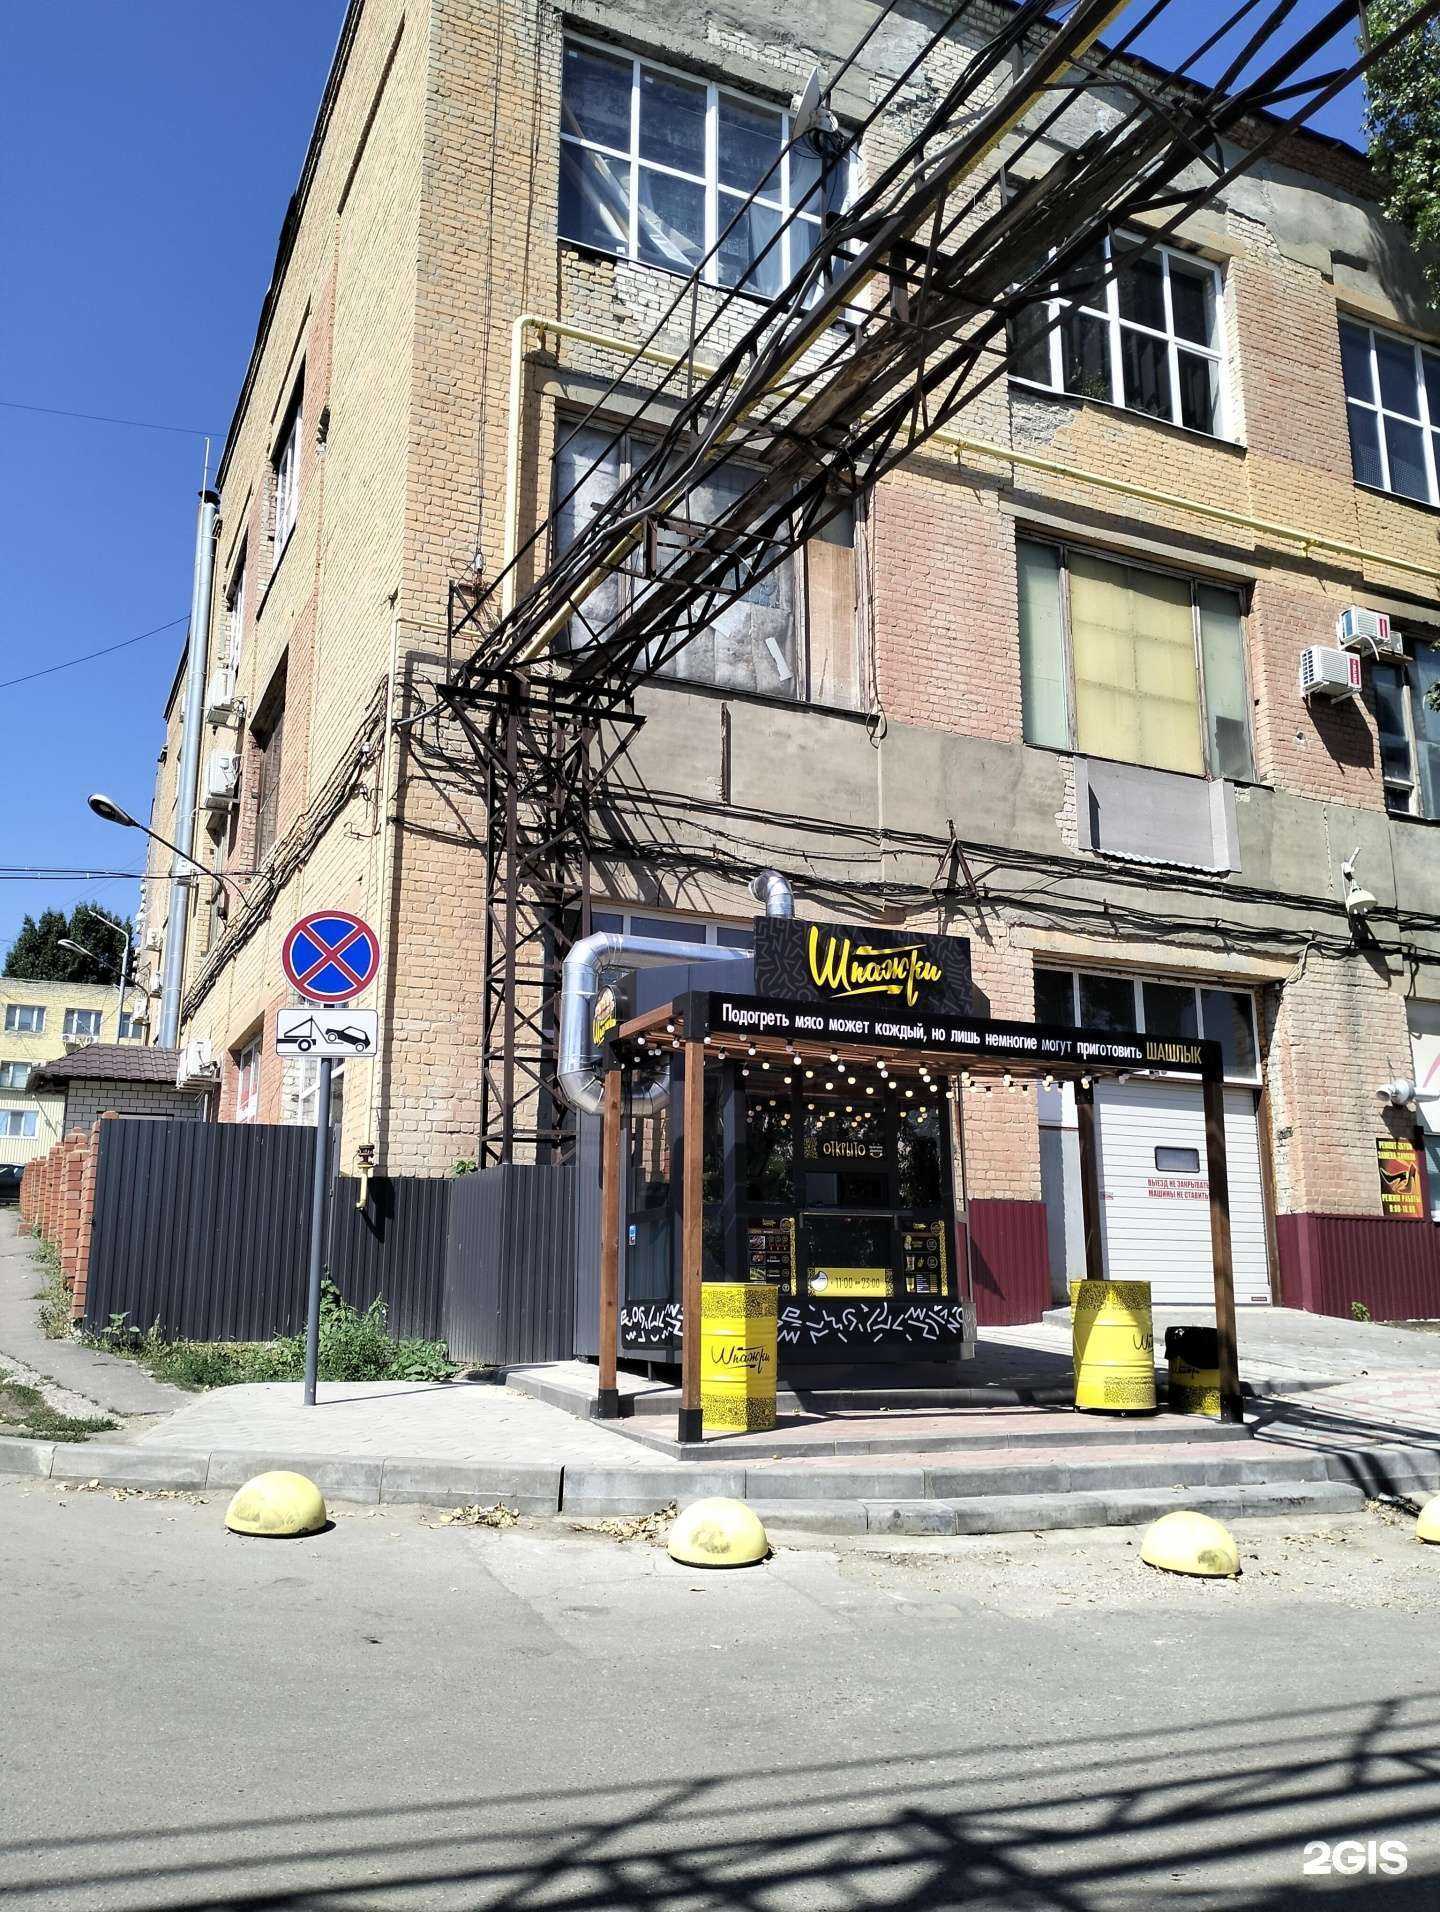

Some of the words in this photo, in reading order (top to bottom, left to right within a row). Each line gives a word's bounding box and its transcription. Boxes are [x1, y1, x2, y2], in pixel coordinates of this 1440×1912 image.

[809, 925, 942, 1007] Шпажки
[721, 1003, 790, 1030] Подогреть
[794, 1015, 824, 1030] мясо
[828, 1018, 870, 1034] может
[874, 1022, 928, 1042] каждый,
[931, 1027, 946, 1041] но
[950, 1029, 981, 1044] лишь
[984, 1032, 1038, 1050] немногие
[1041, 1038, 1072, 1056] могут
[1076, 1042, 1143, 1060] приготовить
[1145, 1042, 1202, 1065] ШАШЛЫК
